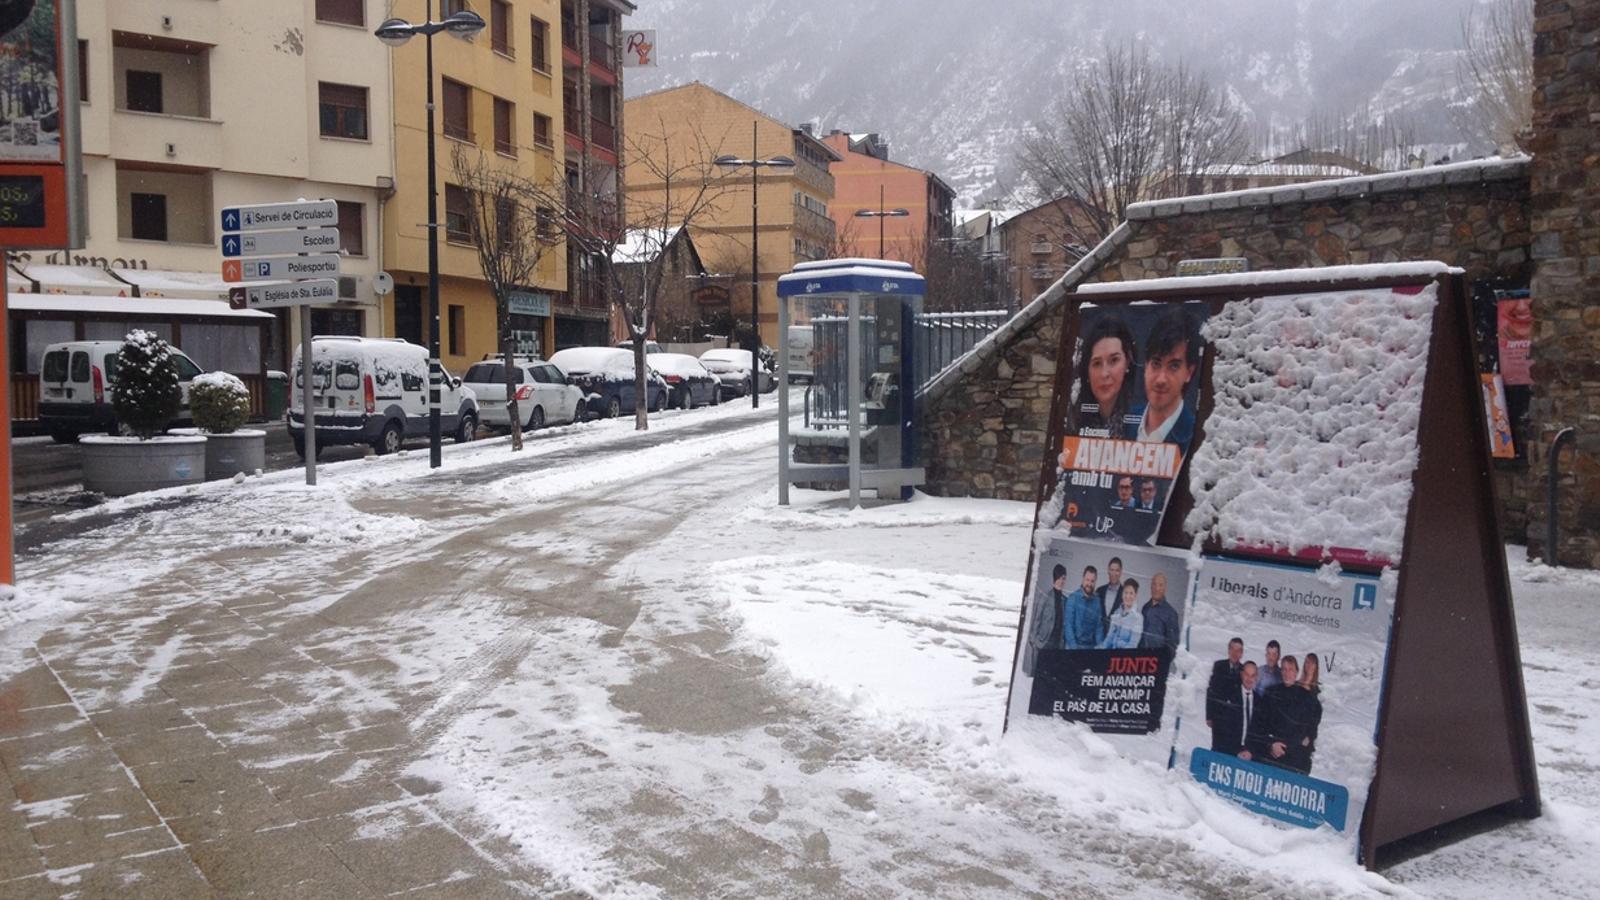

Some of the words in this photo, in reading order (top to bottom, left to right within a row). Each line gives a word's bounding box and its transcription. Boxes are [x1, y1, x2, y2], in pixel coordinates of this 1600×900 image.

[255, 212, 280, 223] Servei
[281, 211, 292, 221] de
[293, 208, 333, 220] Circulació
[304, 235, 335, 246] Escoles
[288, 261, 336, 273] Poliesportiu
[265, 290, 289, 302] Església
[290, 289, 298, 298] de
[300, 288, 311, 298] Sta.
[1073, 438, 1178, 479] AVANCEM
[1072, 471, 1098, 487] amb
[1100, 471, 1113, 488] tu
[1211, 577, 1268, 599] Liberals
[1273, 586, 1342, 610] d'Andorra
[1271, 607, 1340, 628] Independents
[1107, 657, 1158, 673] JUNTS
[1081, 675, 1104, 686] FEM
[1104, 676, 1155, 688] AVANÇAR
[1099, 689, 1144, 700] ENCAMP
[1146, 689, 1151, 700] I
[1053, 701, 1065, 712] EL
[1067, 701, 1086, 712] PAS
[1088, 702, 1104, 713] DE
[1105, 703, 1119, 713] LA
[1121, 703, 1151, 714] CASA
[1234, 769, 1263, 795] MOU
